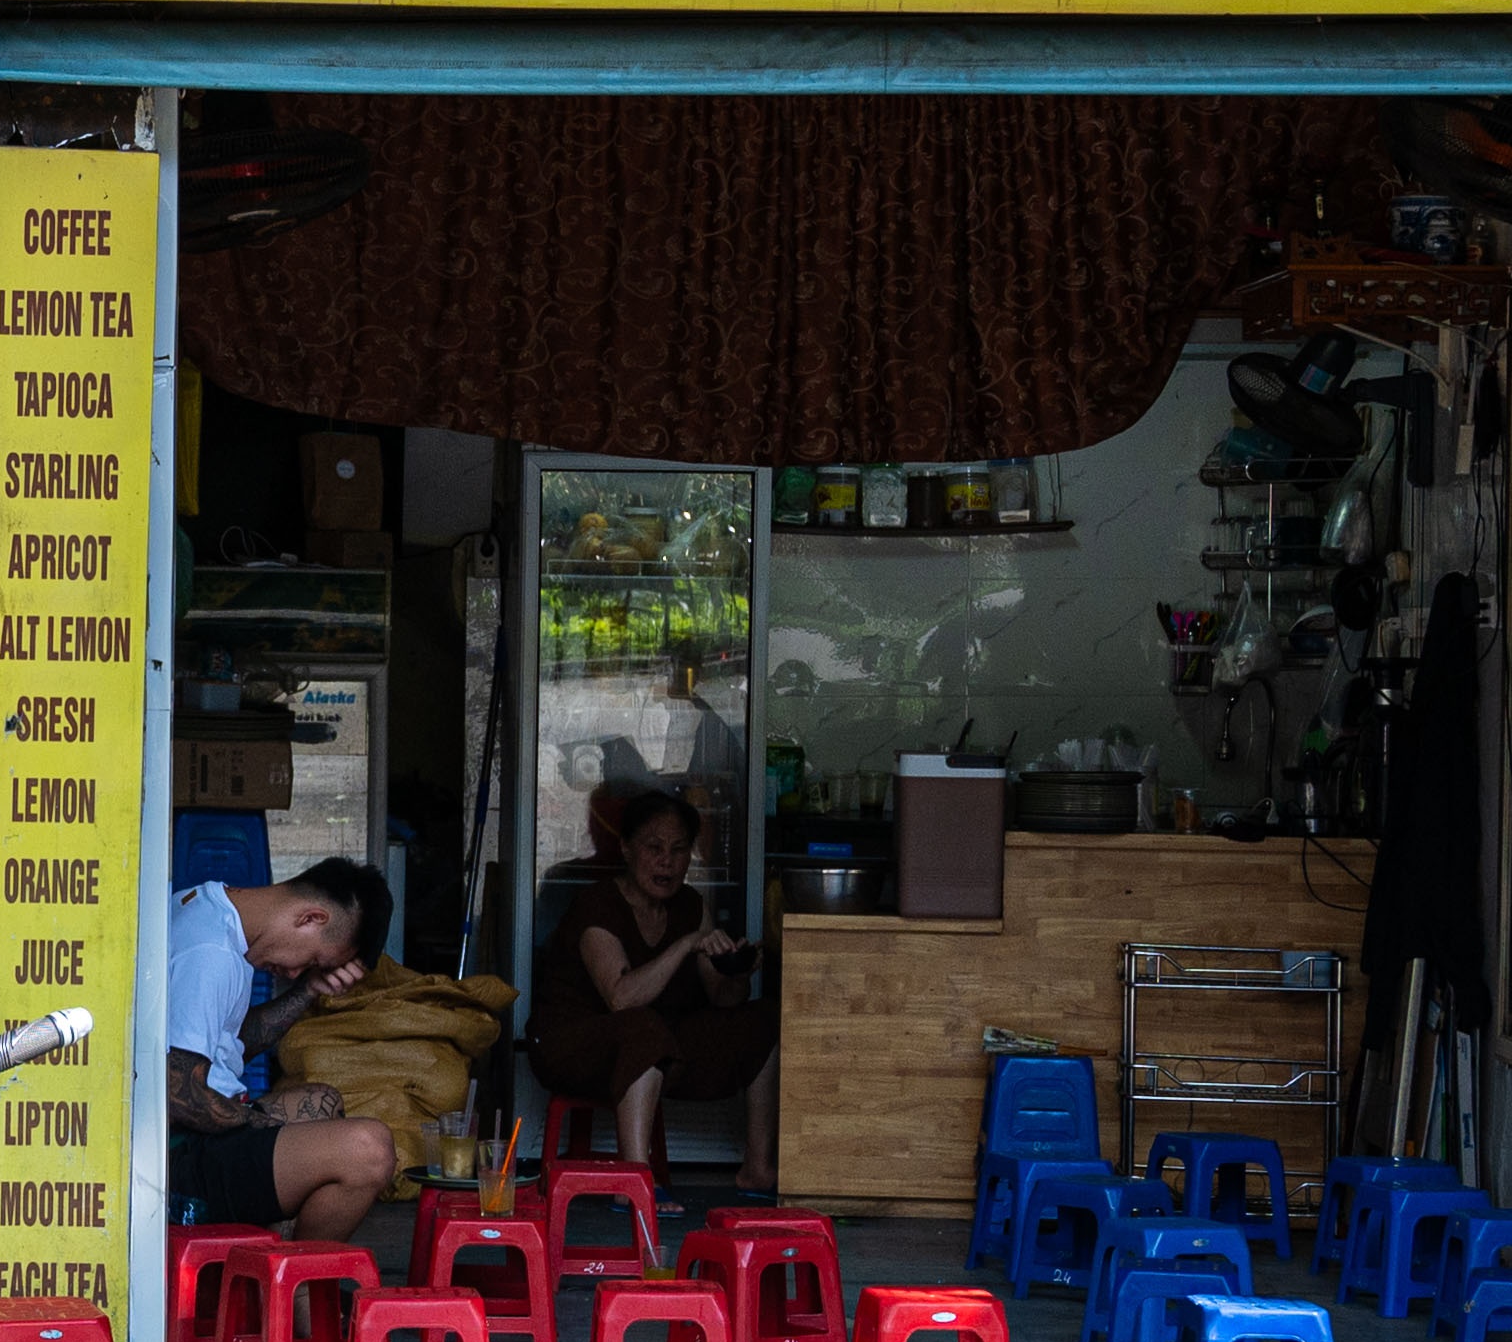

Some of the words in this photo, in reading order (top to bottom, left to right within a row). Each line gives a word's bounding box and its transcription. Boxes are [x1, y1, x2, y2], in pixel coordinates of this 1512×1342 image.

[23, 208, 112, 257] COFFEE
[90, 291, 134, 339] TEA
[14, 371, 114, 419] TAPIOCA
[5, 452, 120, 501] STARLING
[8, 534, 112, 581] APRICOT
[47, 616, 131, 663] LEMON
[17, 696, 96, 743] SRESH
[303, 690, 356, 705] Alaska
[12, 778, 96, 824] LEMON
[4, 859, 100, 905] ORANGE
[15, 940, 85, 986] JUICE
[4, 1101, 89, 1147] LIPTON
[65, 1263, 109, 1308] TEA
[583, 1262, 605, 1275] 24
[1053, 1268, 1072, 1285] 24
